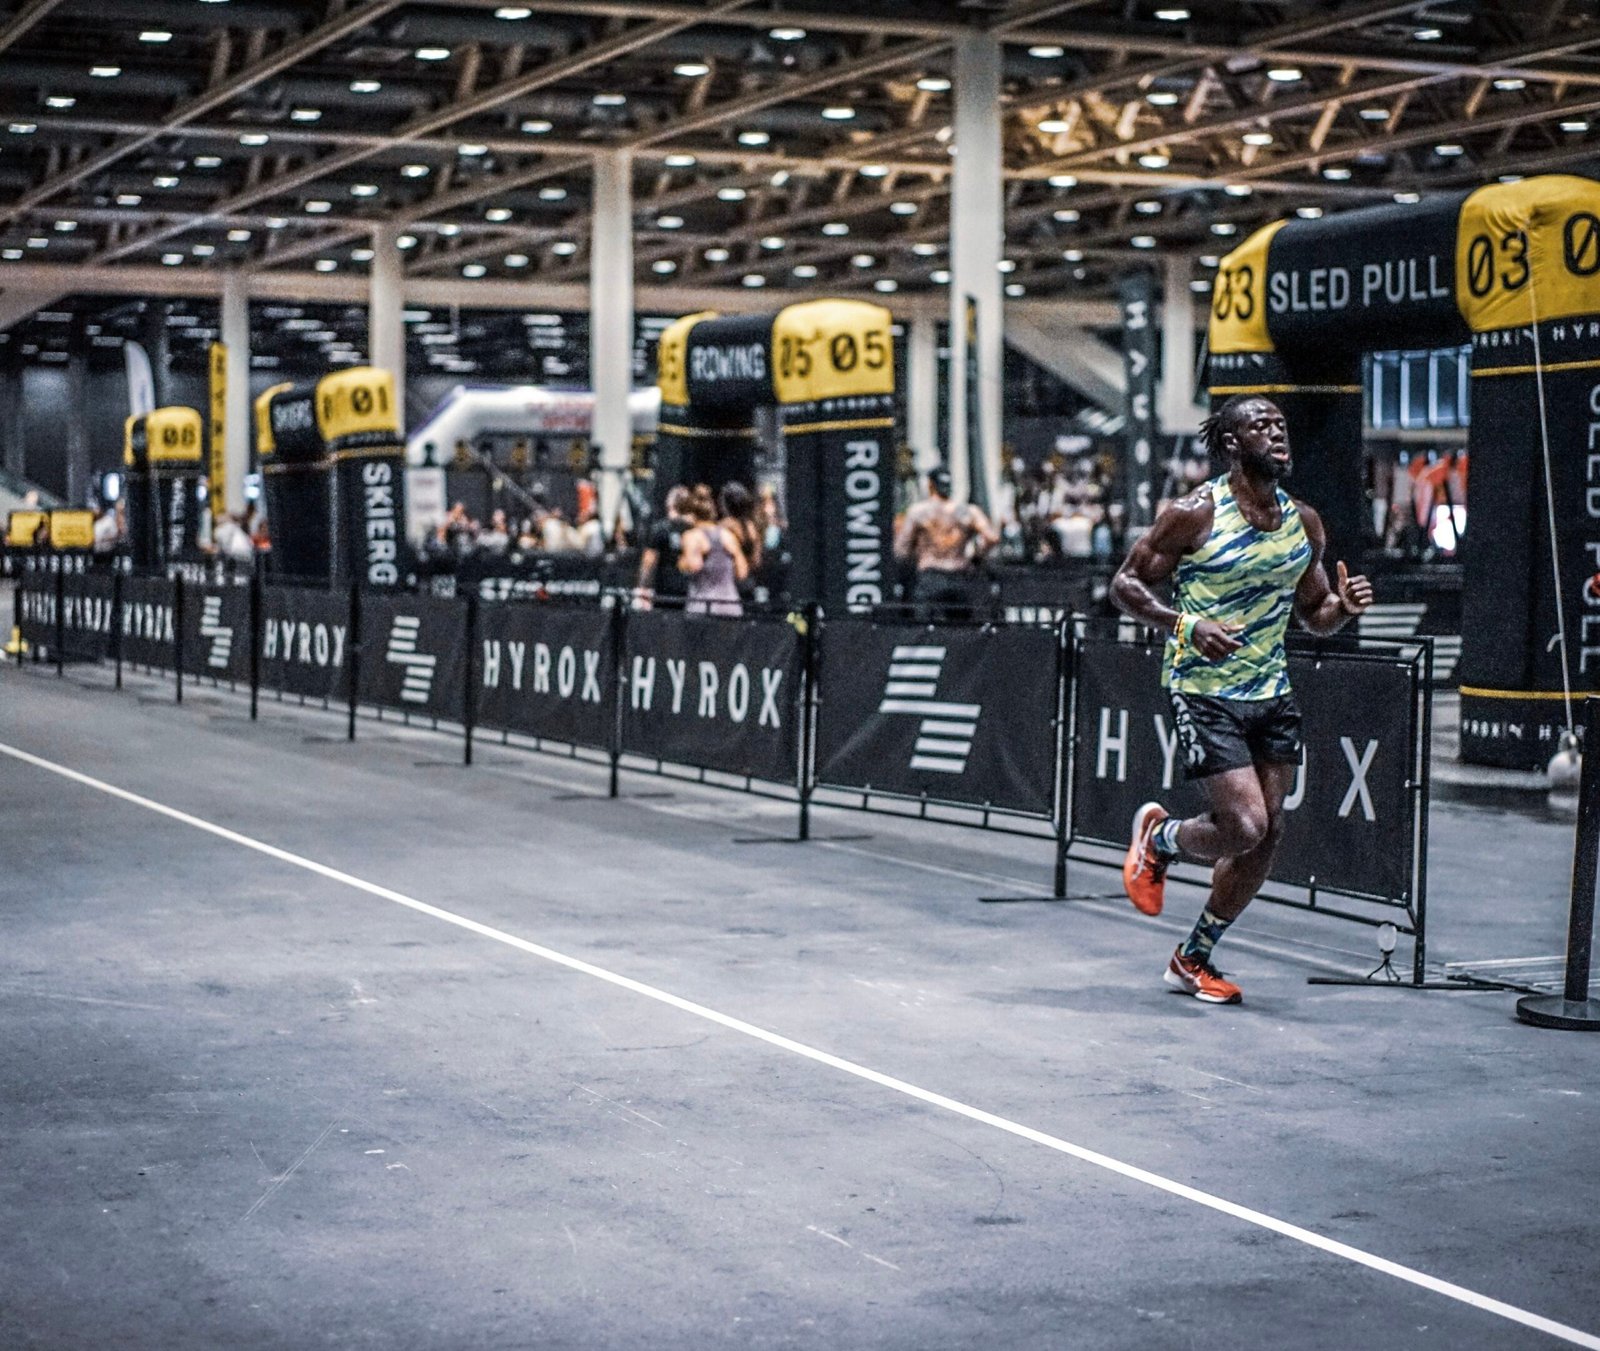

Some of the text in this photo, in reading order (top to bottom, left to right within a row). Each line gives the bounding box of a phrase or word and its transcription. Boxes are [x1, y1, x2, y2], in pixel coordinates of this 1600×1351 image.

[1269, 254, 1450, 314] SLED PULL
[1468, 232, 1530, 298] 03
[690, 342, 767, 381] ROWING
[830, 329, 885, 373] 05
[350, 384, 389, 415] 01
[361, 462, 399, 586] SKIERG
[845, 439, 883, 614] ROWING
[263, 618, 347, 668] HYROX
[483, 639, 601, 704] HYROX
[631, 654, 783, 729] HYROX
[1096, 706, 1379, 823] HYX
